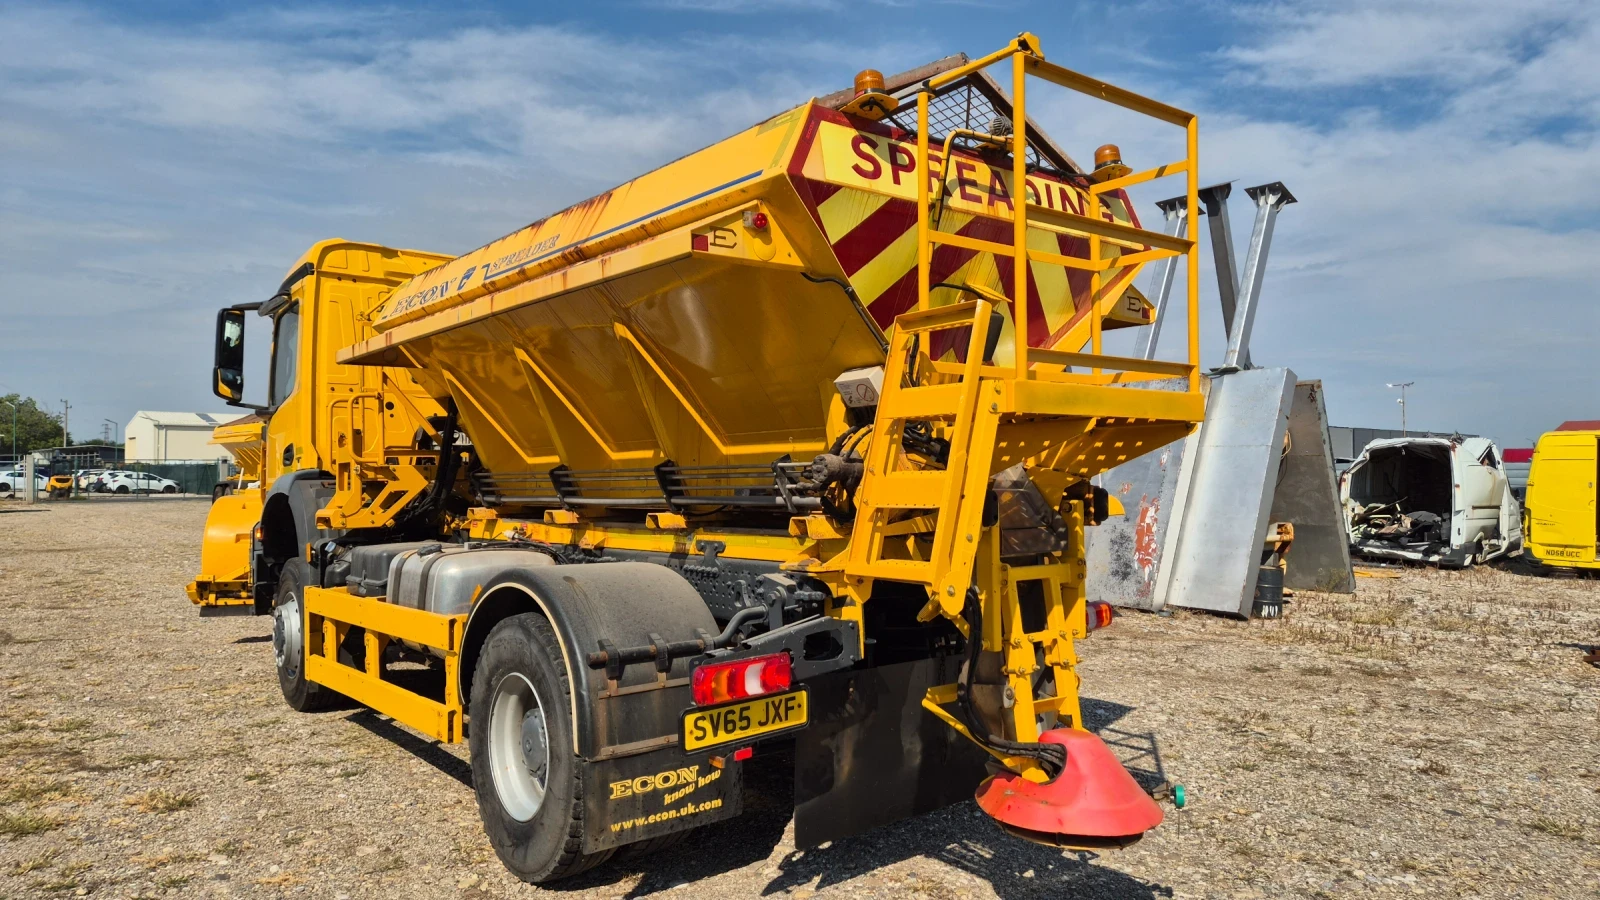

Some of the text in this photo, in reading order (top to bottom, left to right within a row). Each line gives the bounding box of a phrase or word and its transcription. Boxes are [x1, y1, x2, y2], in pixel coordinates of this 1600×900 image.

[693, 696, 796, 742] SV65 JXF
[609, 765, 699, 800] ECON
[664, 769, 721, 806] know how
[610, 798, 722, 832] www.econ.uk.com
